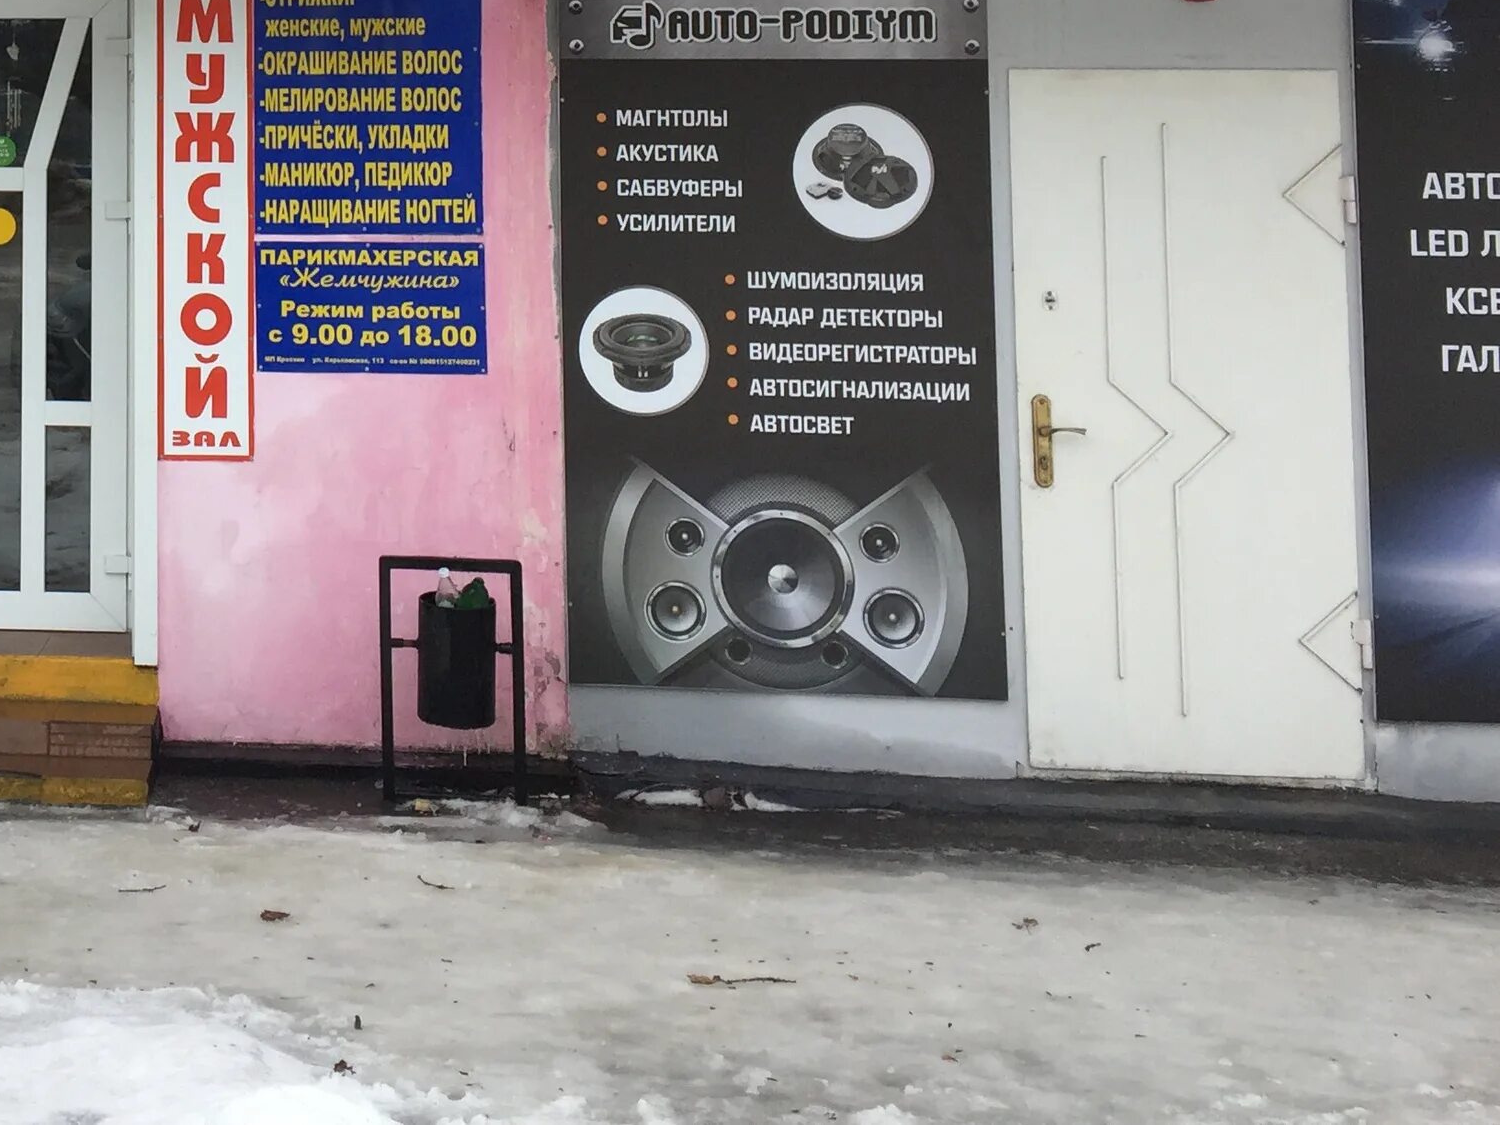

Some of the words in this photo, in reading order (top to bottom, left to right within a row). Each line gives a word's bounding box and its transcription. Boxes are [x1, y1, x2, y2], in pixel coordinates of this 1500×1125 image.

[265, 18, 344, 41] женские,
[350, 17, 426, 42] мужские
[667, 7, 937, 43] AUTO-PODIYM
[403, 50, 462, 74] ВОЛОС
[402, 87, 461, 112] ВОЛОС
[615, 108, 728, 128] МАГНТОЛЫ
[368, 125, 449, 153] УКЛАДКИ
[616, 144, 719, 163] АКУСТИКА
[365, 162, 453, 191] ПЕДИКЮР
[616, 178, 743, 198] САБВУФЕРЫ
[406, 193, 476, 223] НОГТЕЙ
[616, 214, 736, 233] УСИЛИТЕЛИ
[1410, 229, 1469, 257] LED
[260, 249, 478, 266] ПАРИКМАХЕРСКАЯ
[280, 267, 459, 293] «Жемчужина»
[747, 271, 924, 293] ШУМОИЗОЛЯЦИЯ
[281, 300, 364, 318] Режим
[372, 302, 461, 322] работы
[748, 307, 814, 327] РАДАР
[820, 308, 942, 328] ДЕТЕКТОРЫ
[292, 325, 353, 345] 9.00
[360, 331, 390, 347] до
[398, 325, 477, 347] 18.00
[749, 343, 976, 365] ВИДЕОРЕГИСТРАТОРЫ
[750, 378, 970, 403] АВТОСИГНАЛИЗАЦИИ
[750, 414, 854, 434] АВТОСВЕТ
[172, 430, 242, 448] ЗАЛ
